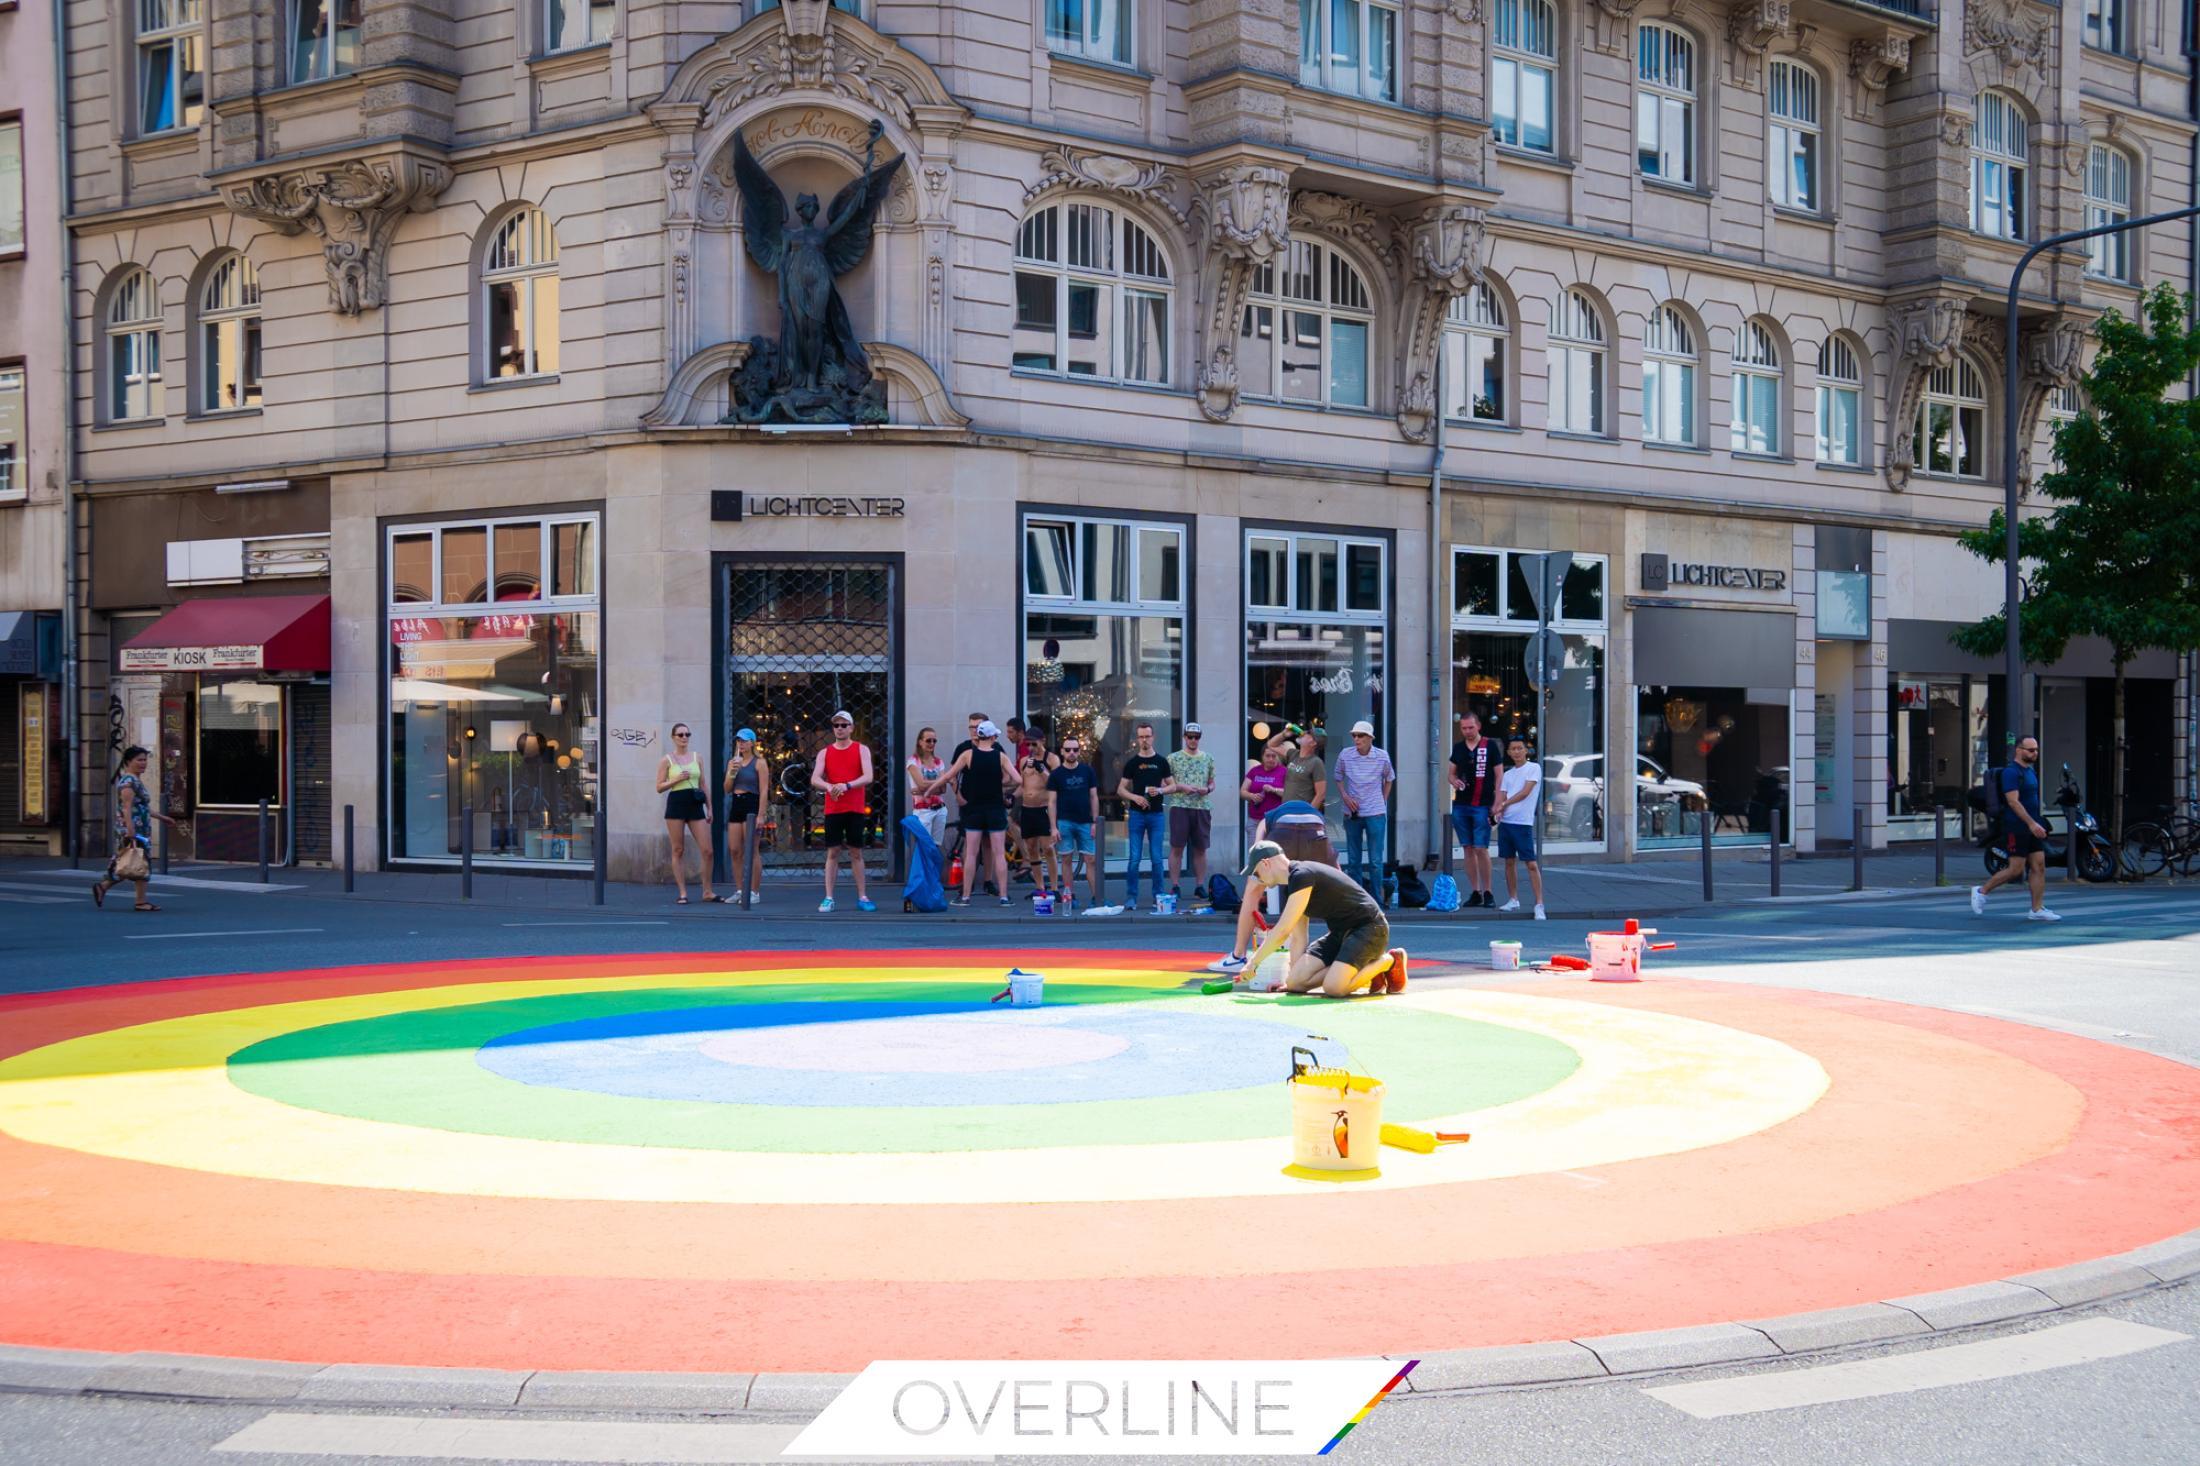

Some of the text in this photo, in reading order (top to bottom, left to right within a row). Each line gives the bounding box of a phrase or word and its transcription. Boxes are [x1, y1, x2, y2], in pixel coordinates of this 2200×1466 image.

[126, 650, 168, 660] Frankfurter
[173, 651, 207, 665] KIOSK
[213, 648, 257, 659] Frankfurter
